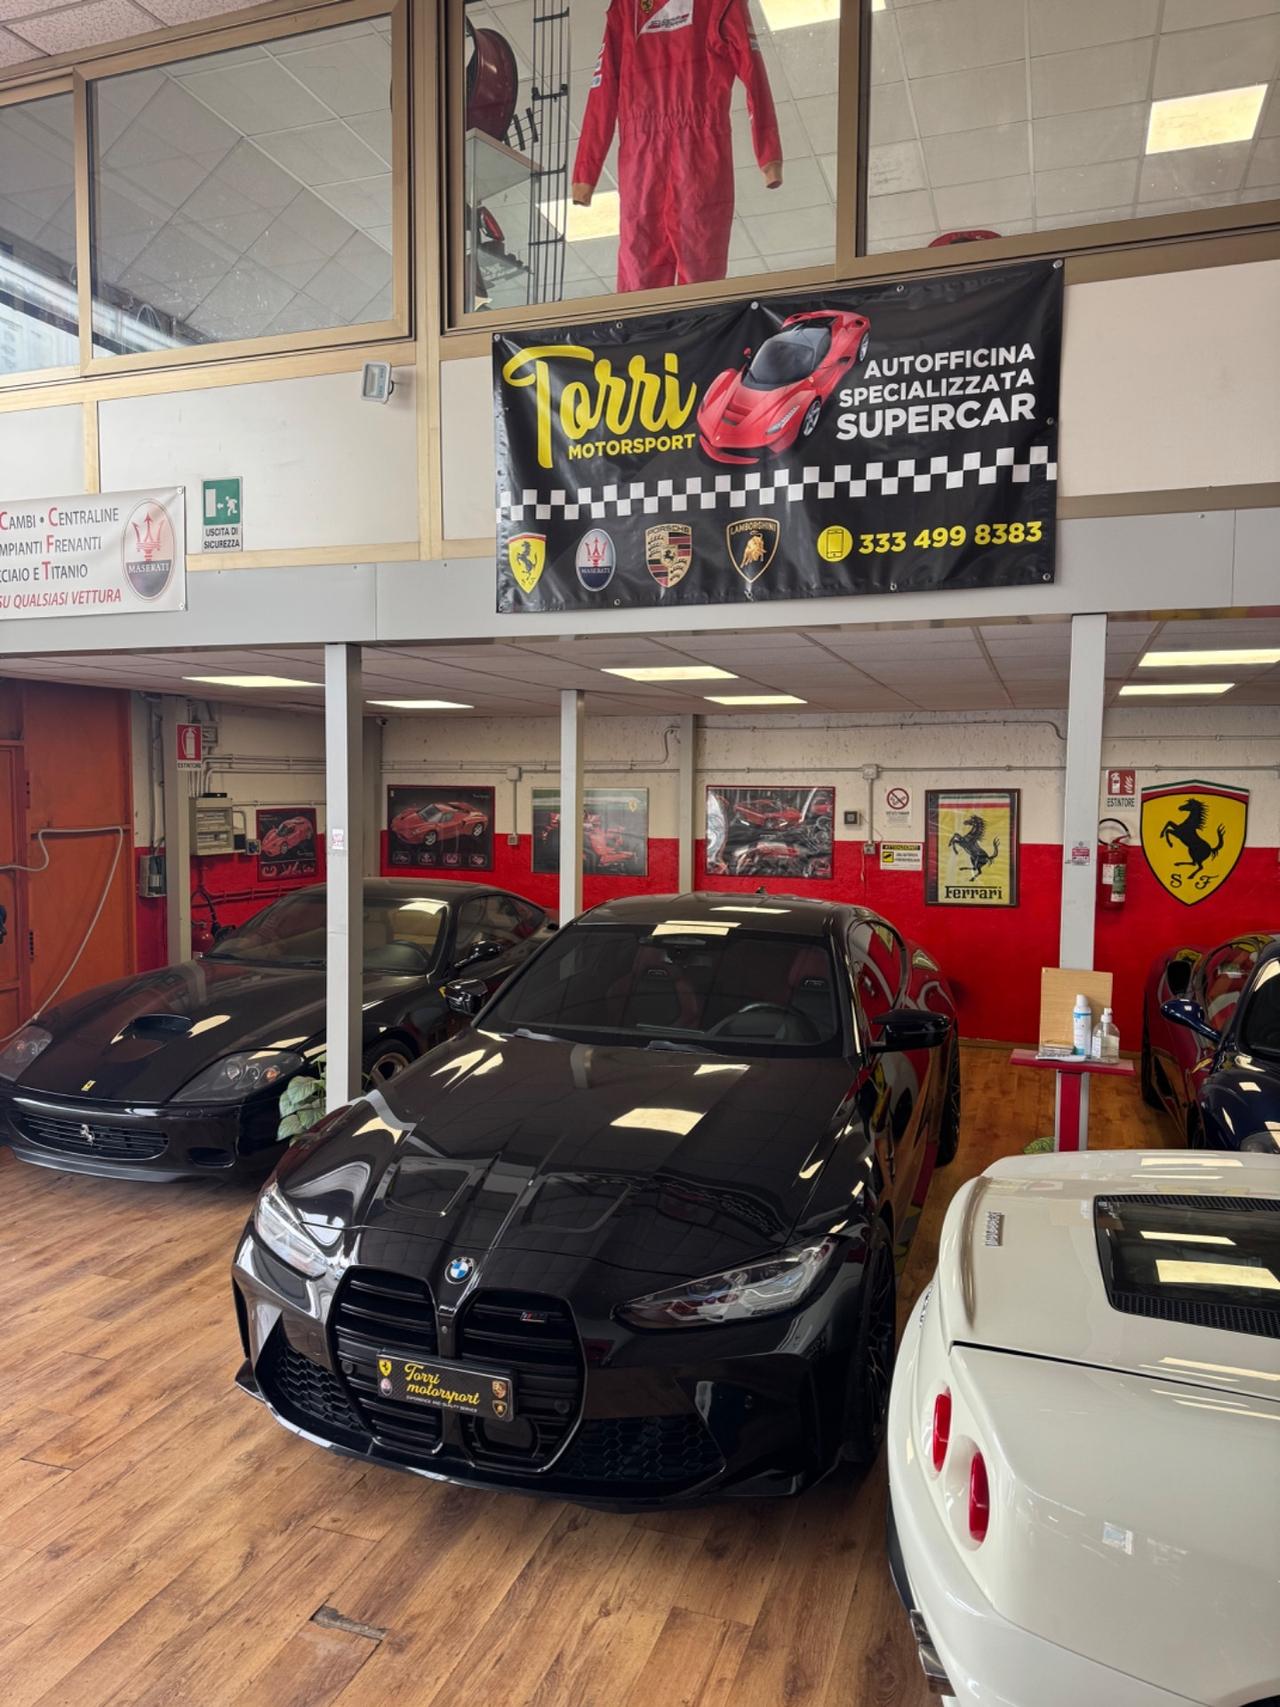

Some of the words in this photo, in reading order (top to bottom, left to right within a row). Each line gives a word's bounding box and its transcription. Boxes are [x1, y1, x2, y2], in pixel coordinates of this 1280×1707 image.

[864, 342, 1036, 379] AUTOFFICINA
[838, 368, 1035, 407] SPECIALIZZATA
[503, 345, 697, 469] Torri
[836, 392, 1036, 440] SUPERCAR
[568, 433, 696, 460] MOTORSPORT
[48, 507, 119, 527] CENTRALINE
[205, 527, 230, 537] USCITA
[231, 526, 239, 535] DI
[648, 525, 690, 536] PORSCHE
[730, 521, 776, 534] LAMBORGHINI
[858, 531, 907, 555] 333
[913, 525, 967, 549] 499
[974, 520, 1042, 545] 8383
[46, 535, 102, 554] FRENANTI
[204, 538, 240, 549] SICUREZZA
[0, 567, 30, 583] CIAIO
[33, 567, 40, 581] E
[41, 561, 88, 580] TITANIO
[128, 562, 169, 574] MASERATI
[13, 591, 69, 609] QUALSIASI
[71, 589, 122, 605] VETTURA
[1170, 873, 1182, 888] S
[1195, 874, 1219, 889] F
[945, 886, 1002, 899] Ferrari
[404, 1363, 440, 1384] Torri
[407, 1383, 480, 1405] motorsport
